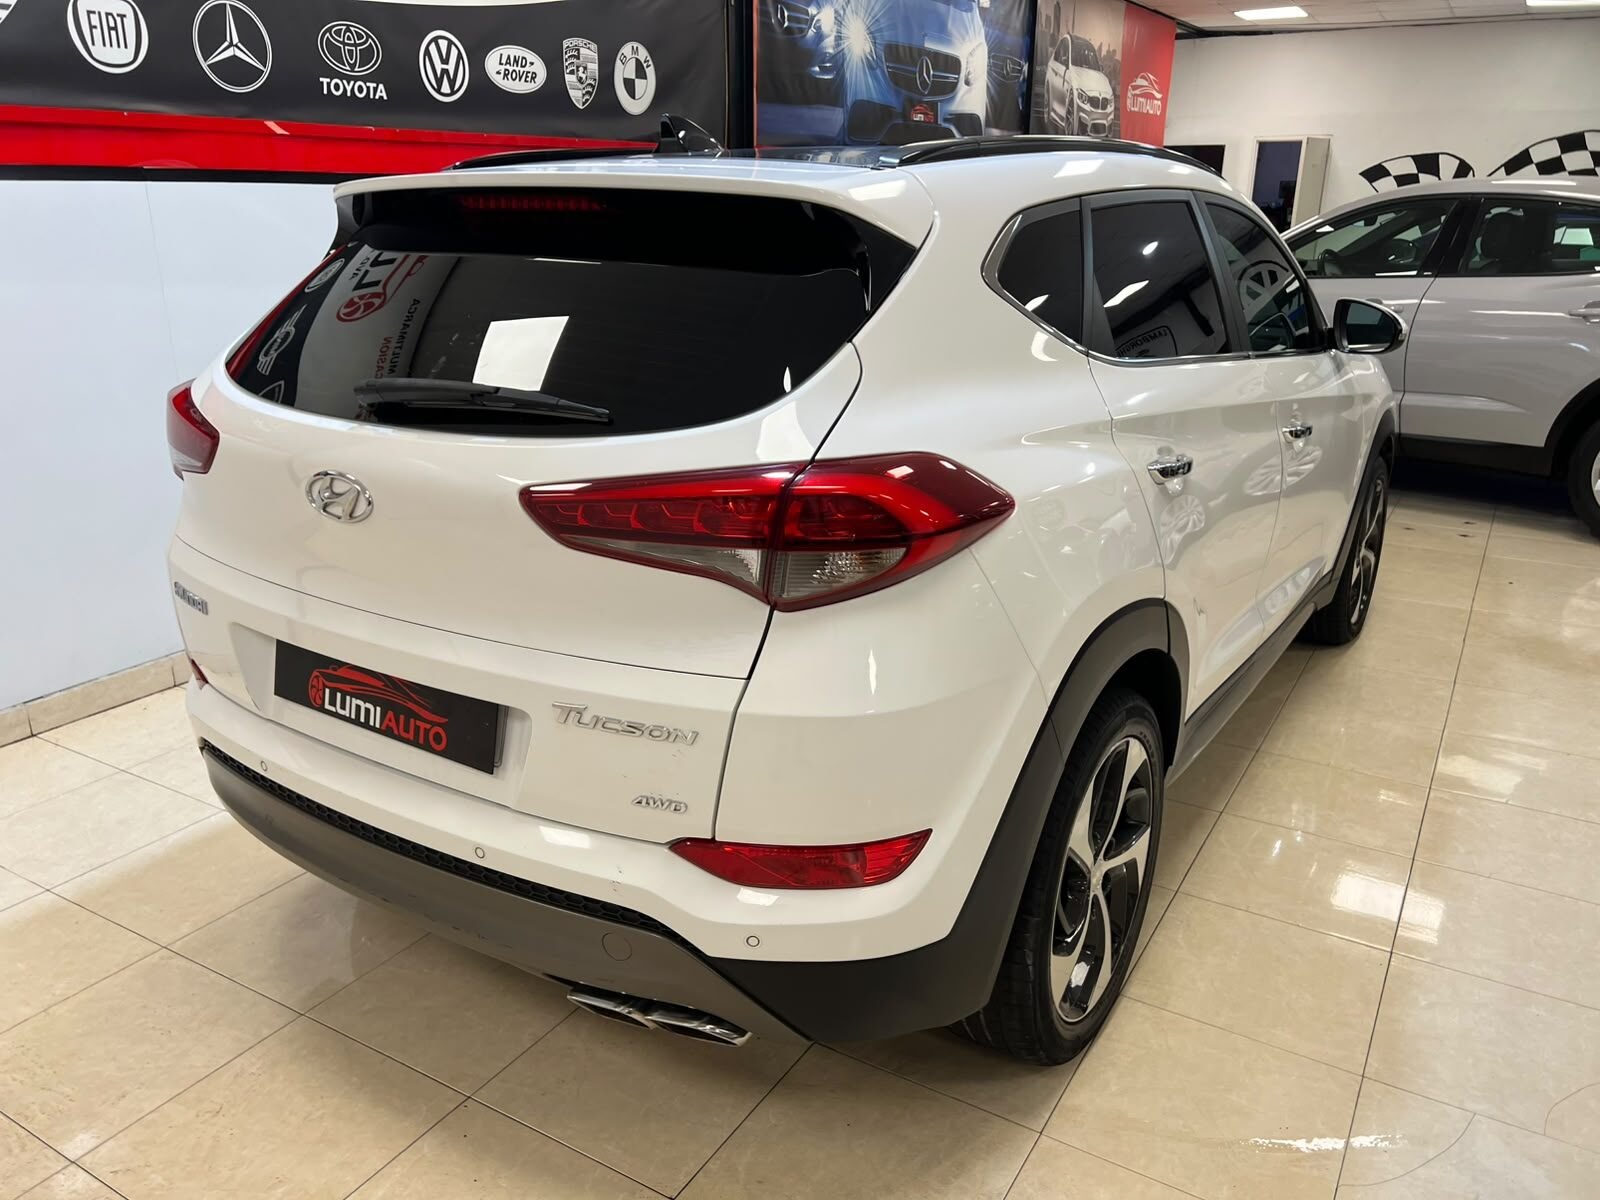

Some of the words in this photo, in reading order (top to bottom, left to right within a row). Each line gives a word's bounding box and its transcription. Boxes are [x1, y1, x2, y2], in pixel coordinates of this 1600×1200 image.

[86, 10, 129, 49] FIAT
[563, 40, 598, 54] PORSCHE
[619, 45, 652, 70] BMW
[498, 53, 528, 68] LAND
[502, 69, 538, 84] ROVER
[319, 77, 388, 100] TOYOTA
[552, 701, 699, 746] TUCSON
[632, 795, 688, 815] 4WD
